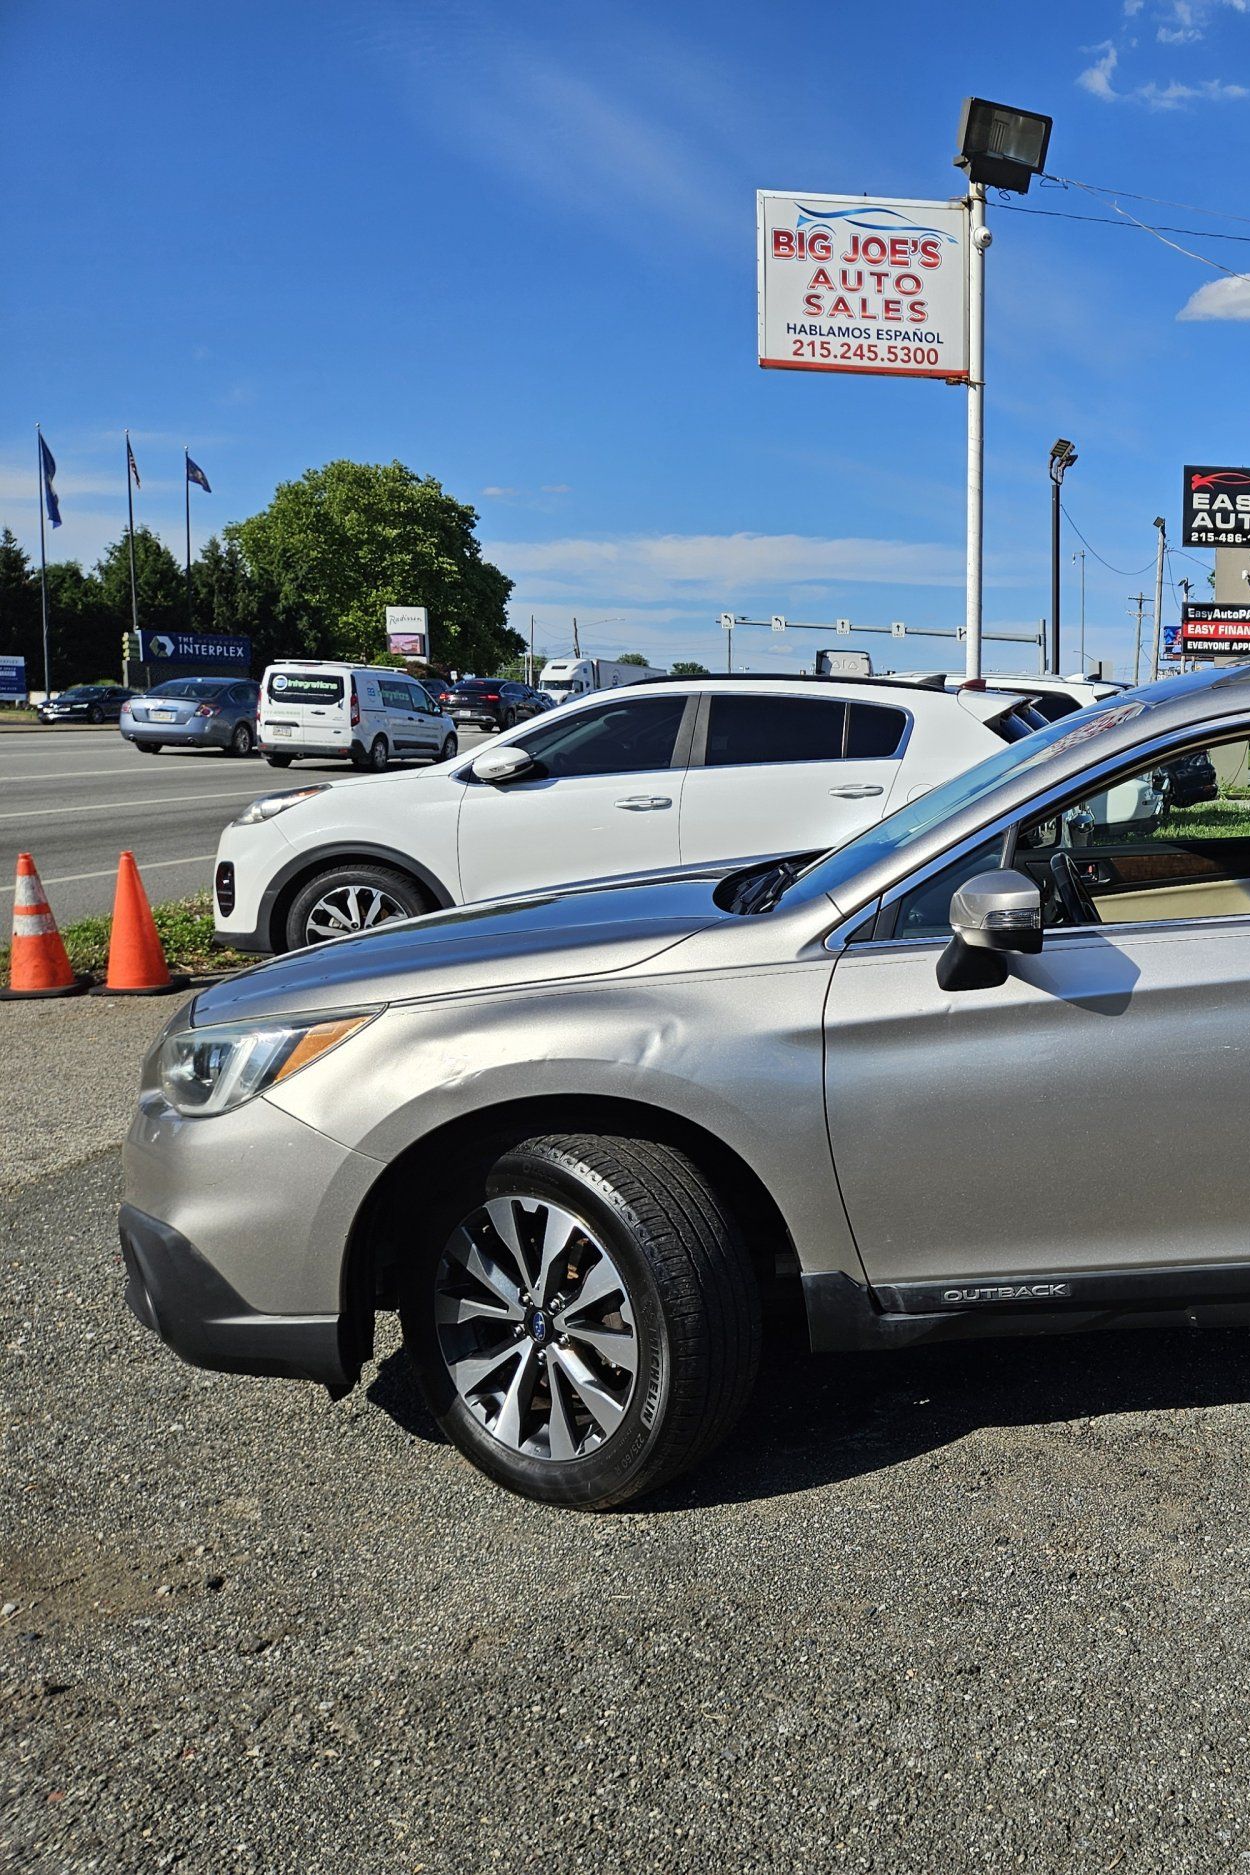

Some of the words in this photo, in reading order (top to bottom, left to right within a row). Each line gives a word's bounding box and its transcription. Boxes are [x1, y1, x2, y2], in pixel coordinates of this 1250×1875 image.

[772, 229, 833, 261] BIG
[841, 234, 942, 269] JOE'S
[808, 267, 922, 295] AUTO
[803, 294, 928, 322] SALES
[786, 323, 871, 339] HABLAMOS
[876, 329, 944, 344] ESPAÑOL
[792, 339, 939, 365] 215.245.5300
[1187, 624, 1216, 634] EASY
[179, 644, 244, 657] INTERPLEX
[1187, 641, 1230, 650] EVERYONE
[943, 1283, 1067, 1301] OUTBACK
